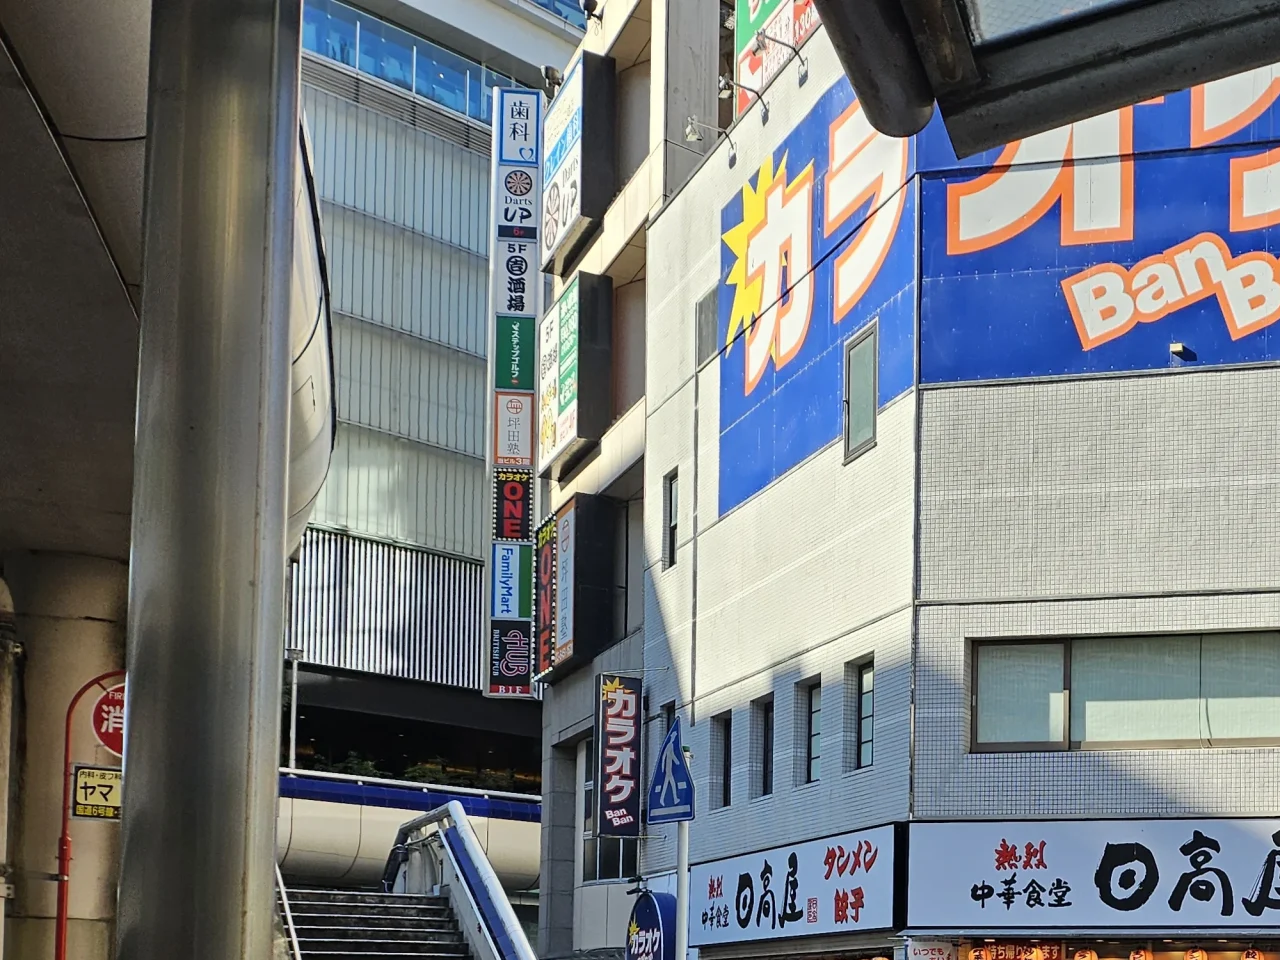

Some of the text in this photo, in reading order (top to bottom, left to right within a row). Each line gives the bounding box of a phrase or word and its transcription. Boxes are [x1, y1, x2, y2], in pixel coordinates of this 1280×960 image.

[509, 101, 530, 142] 歯科
[504, 207, 532, 223] UP
[505, 196, 533, 206] Darts
[507, 243, 527, 254] 5F
[507, 417, 520, 455] 坪田塾
[498, 473, 529, 481] カラオケ
[503, 481, 524, 538] ONE
[500, 547, 514, 614] FamilyMart
[539, 543, 552, 673] ONE
[500, 629, 529, 677] HUB
[492, 662, 500, 676] PUB
[604, 687, 636, 804] カラオケ
[80, 781, 114, 801] ヤマ
[605, 808, 627, 821] Ban
[612, 814, 634, 826] Ban
[823, 839, 878, 881] タンメン
[994, 838, 1048, 871] 熱烈
[708, 874, 723, 900] 熱烈
[736, 851, 804, 930] 日高屋
[970, 872, 1073, 911] 中華食堂
[701, 901, 730, 931] 中華食堂
[834, 886, 865, 924] 餃子
[630, 928, 661, 955] カラオケ
[913, 947, 944, 956] いつでも
